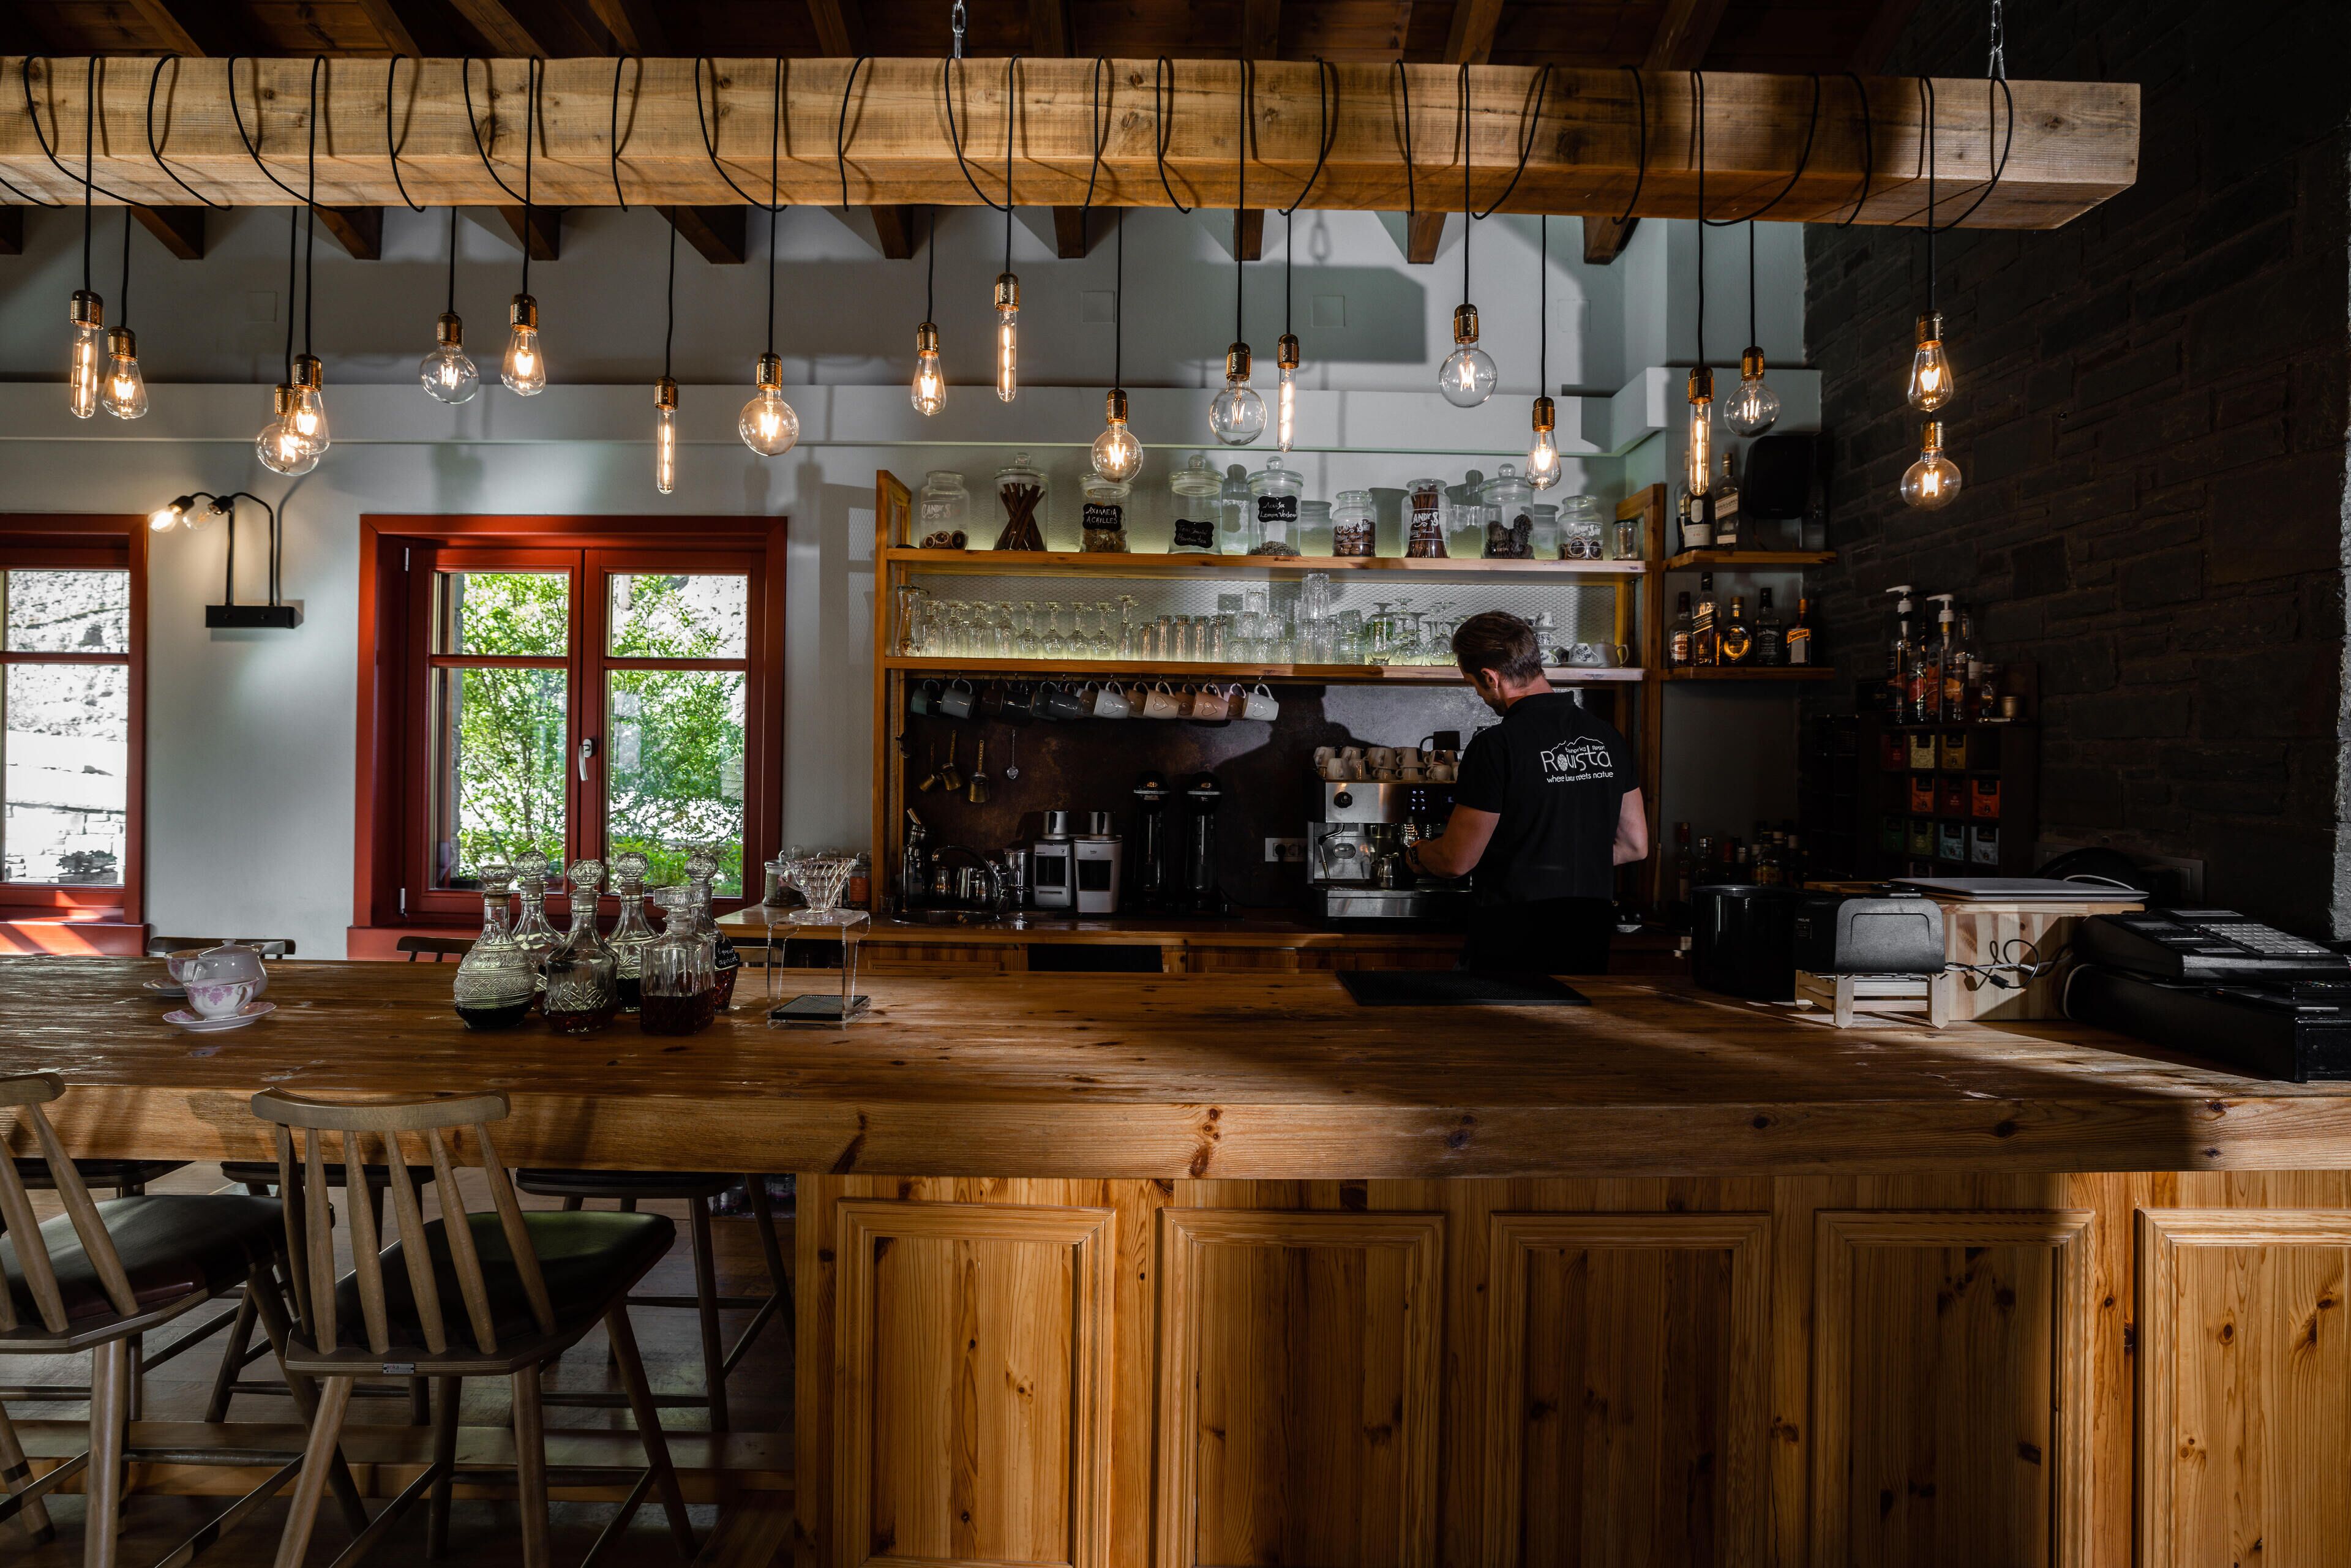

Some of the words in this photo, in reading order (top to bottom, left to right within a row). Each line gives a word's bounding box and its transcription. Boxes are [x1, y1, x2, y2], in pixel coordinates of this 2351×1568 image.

[1259, 511, 1280, 519] Lemon
[1412, 512, 1432, 524] ANDY
[1087, 516, 1118, 526] ACHILLES
